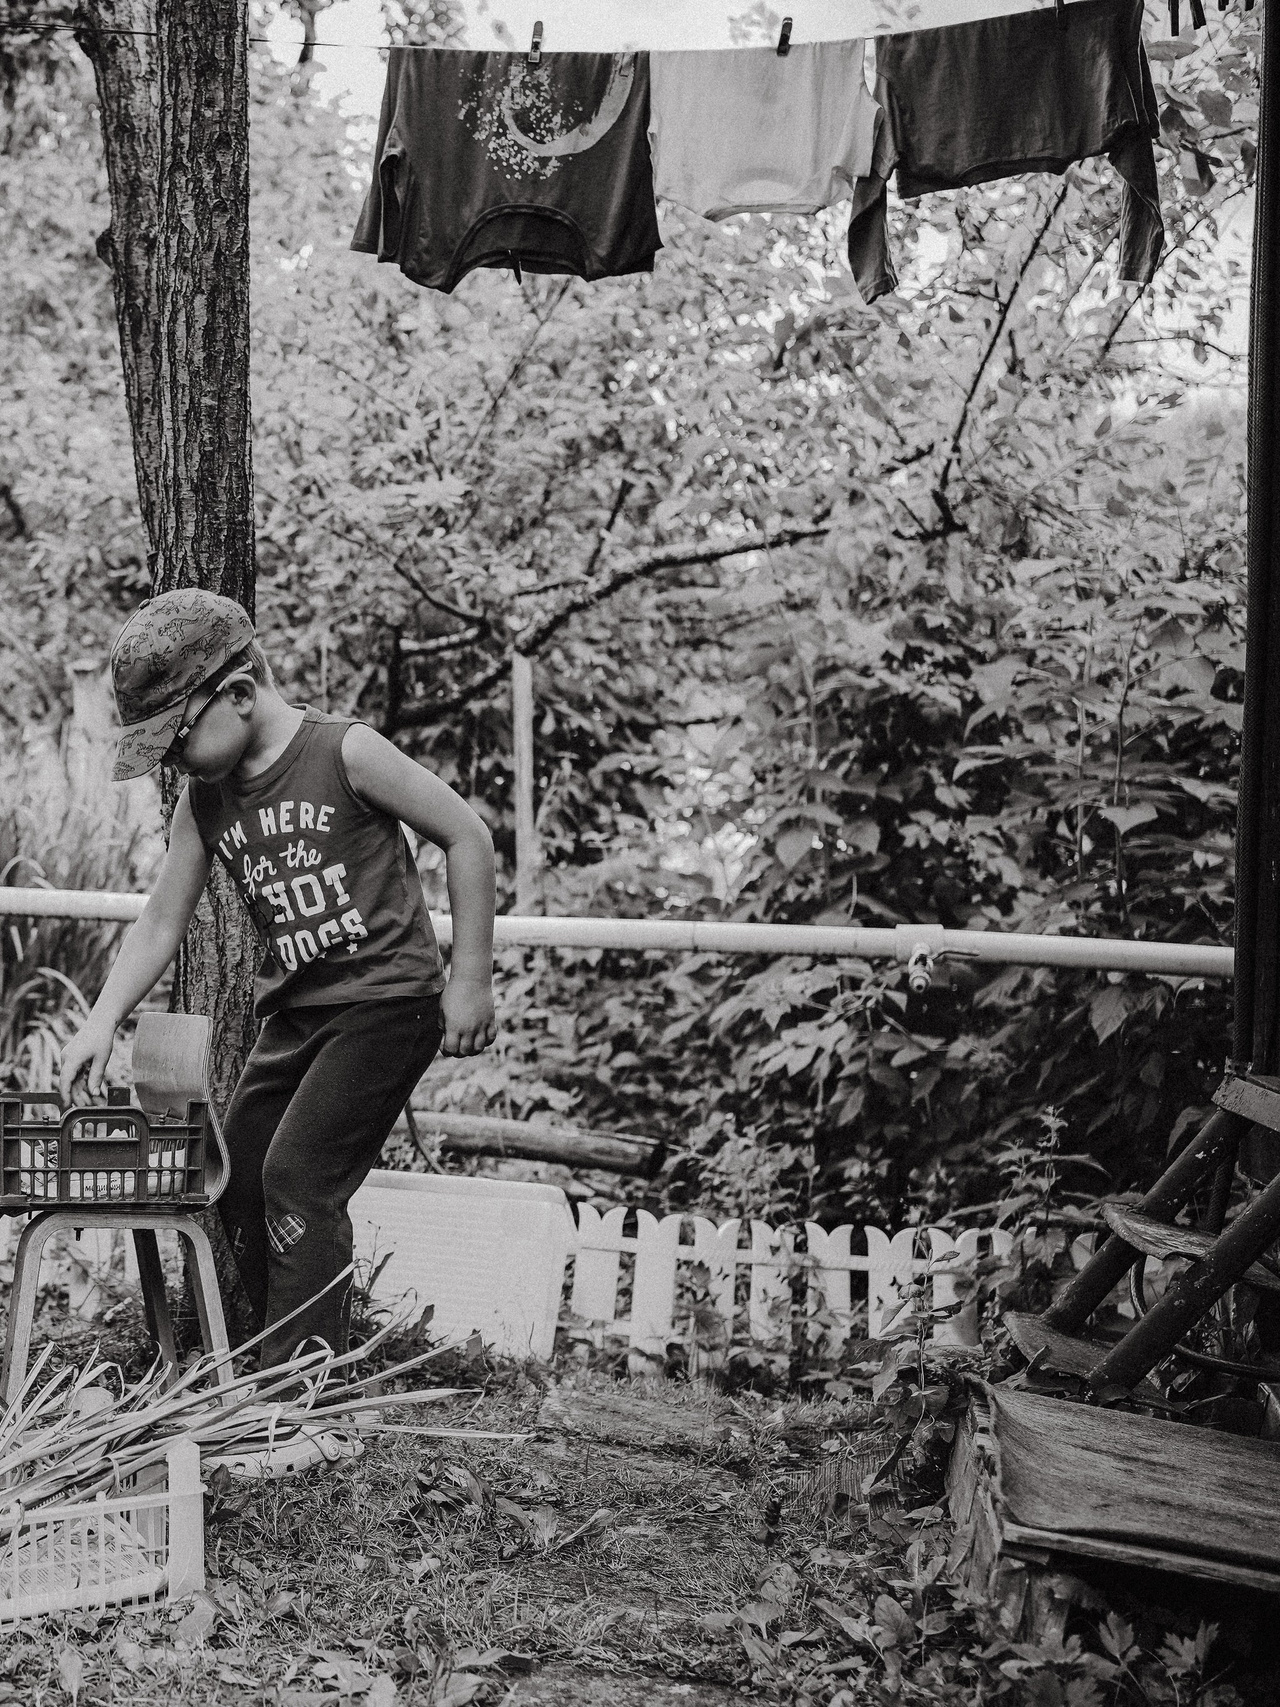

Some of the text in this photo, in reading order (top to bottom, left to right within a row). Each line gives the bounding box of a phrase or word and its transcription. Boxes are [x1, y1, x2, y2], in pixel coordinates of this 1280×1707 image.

[219, 800, 335, 860] I'M HERE
[242, 839, 321, 904] for the
[261, 863, 350, 923] HOT
[276, 908, 368, 971] DOGS
